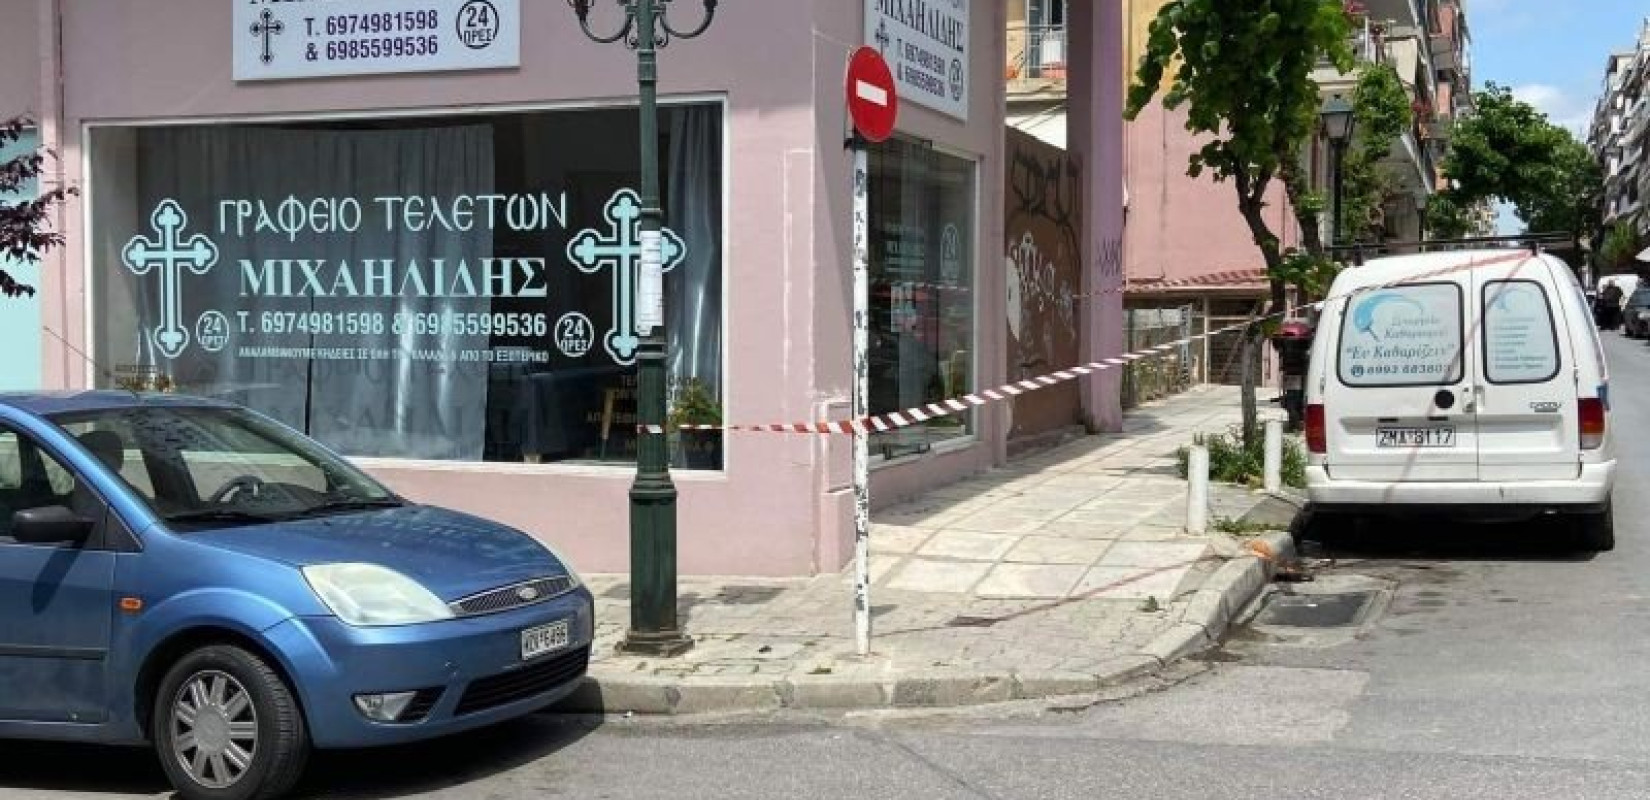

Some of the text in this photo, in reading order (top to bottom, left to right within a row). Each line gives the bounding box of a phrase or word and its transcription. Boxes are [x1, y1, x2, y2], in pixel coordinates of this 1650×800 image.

[326, 10, 438, 36] 6974981598
[465, 7, 489, 28] 24
[304, 35, 438, 62] & 6985599536
[219, 190, 567, 242] ΓΡΑΦΕΙΟ ΤΕΛΕΤΩΝ
[238, 256, 548, 298] ΜΙΧΑΗΛΙΔΗΣ
[203, 317, 222, 333] 24
[262, 311, 385, 335] 6974981598
[564, 319, 584, 337] 24
